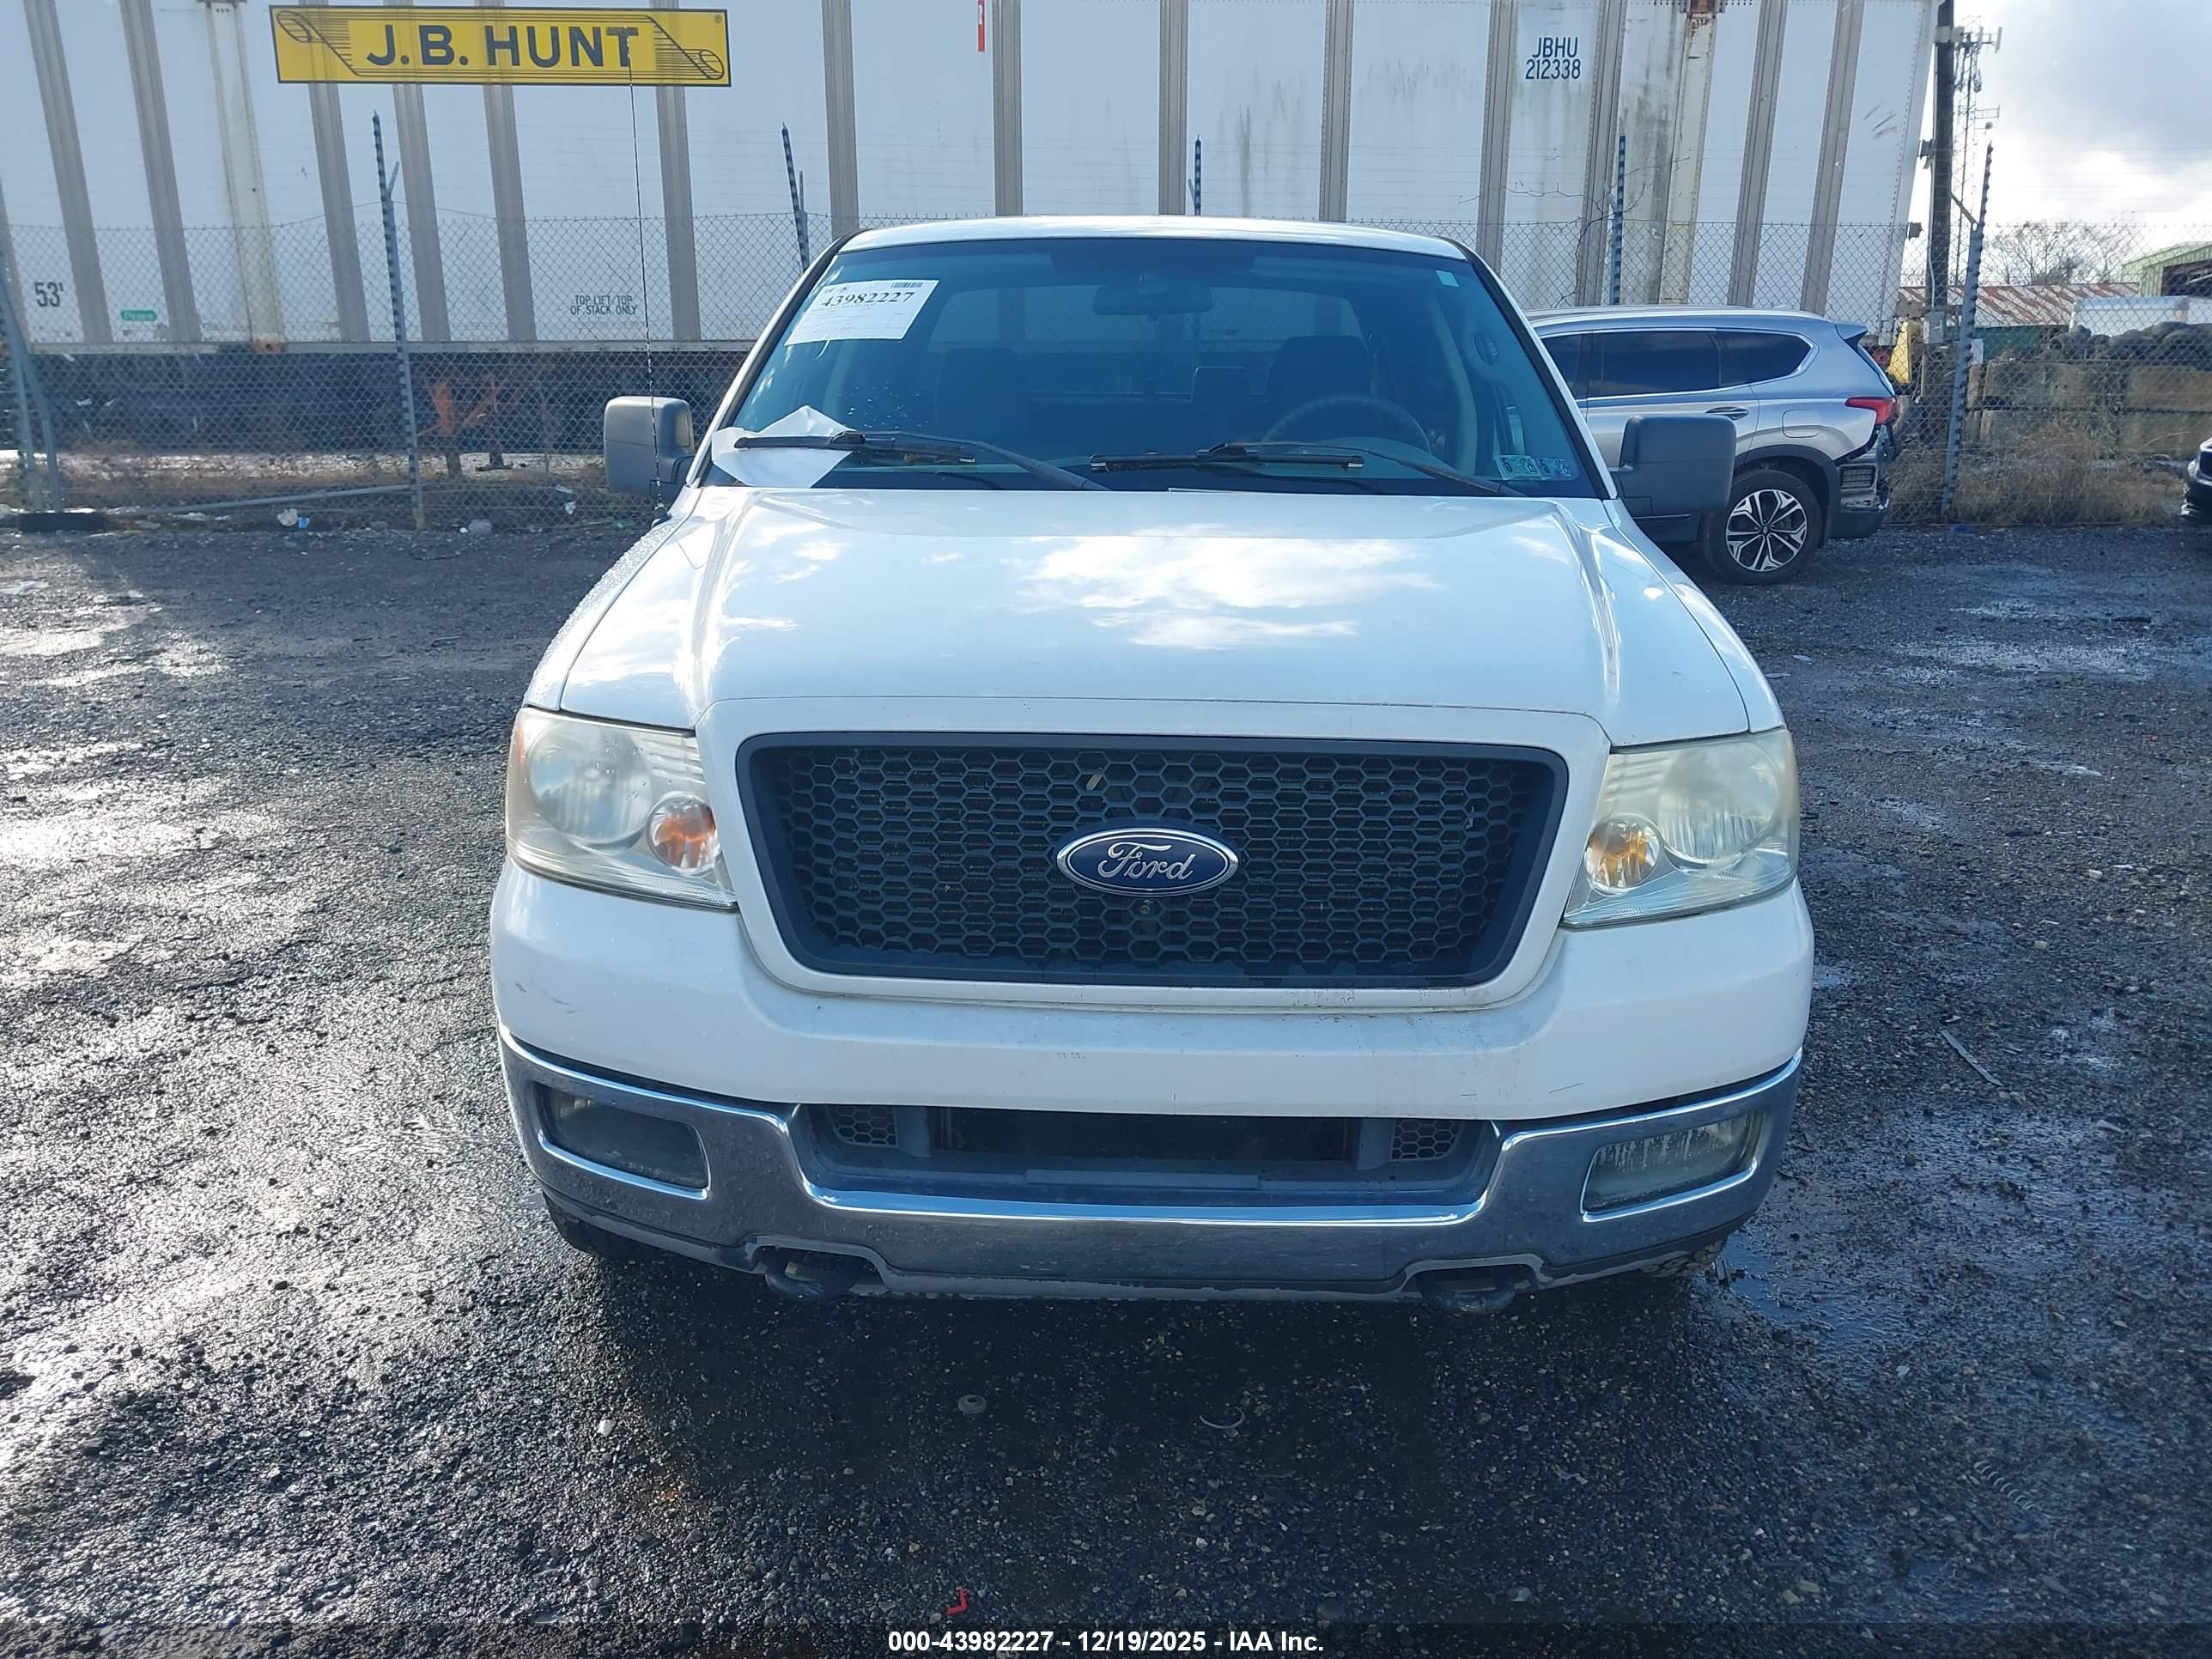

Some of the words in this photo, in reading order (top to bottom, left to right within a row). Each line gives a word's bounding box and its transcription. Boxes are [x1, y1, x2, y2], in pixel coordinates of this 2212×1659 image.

[367, 24, 468, 65] J.B.
[484, 26, 639, 68] HUNT
[1532, 37, 1578, 58] JBHU
[1525, 58, 1581, 79] 212338
[34, 282, 64, 307] 53'
[574, 295, 591, 305] TOP
[617, 295, 633, 305] TOP
[821, 292, 916, 307] 43982227
[570, 305, 582, 315] OF
[586, 305, 611, 315] STACK
[616, 304, 638, 315] ONLY
[1097, 842, 1196, 879] Ford
